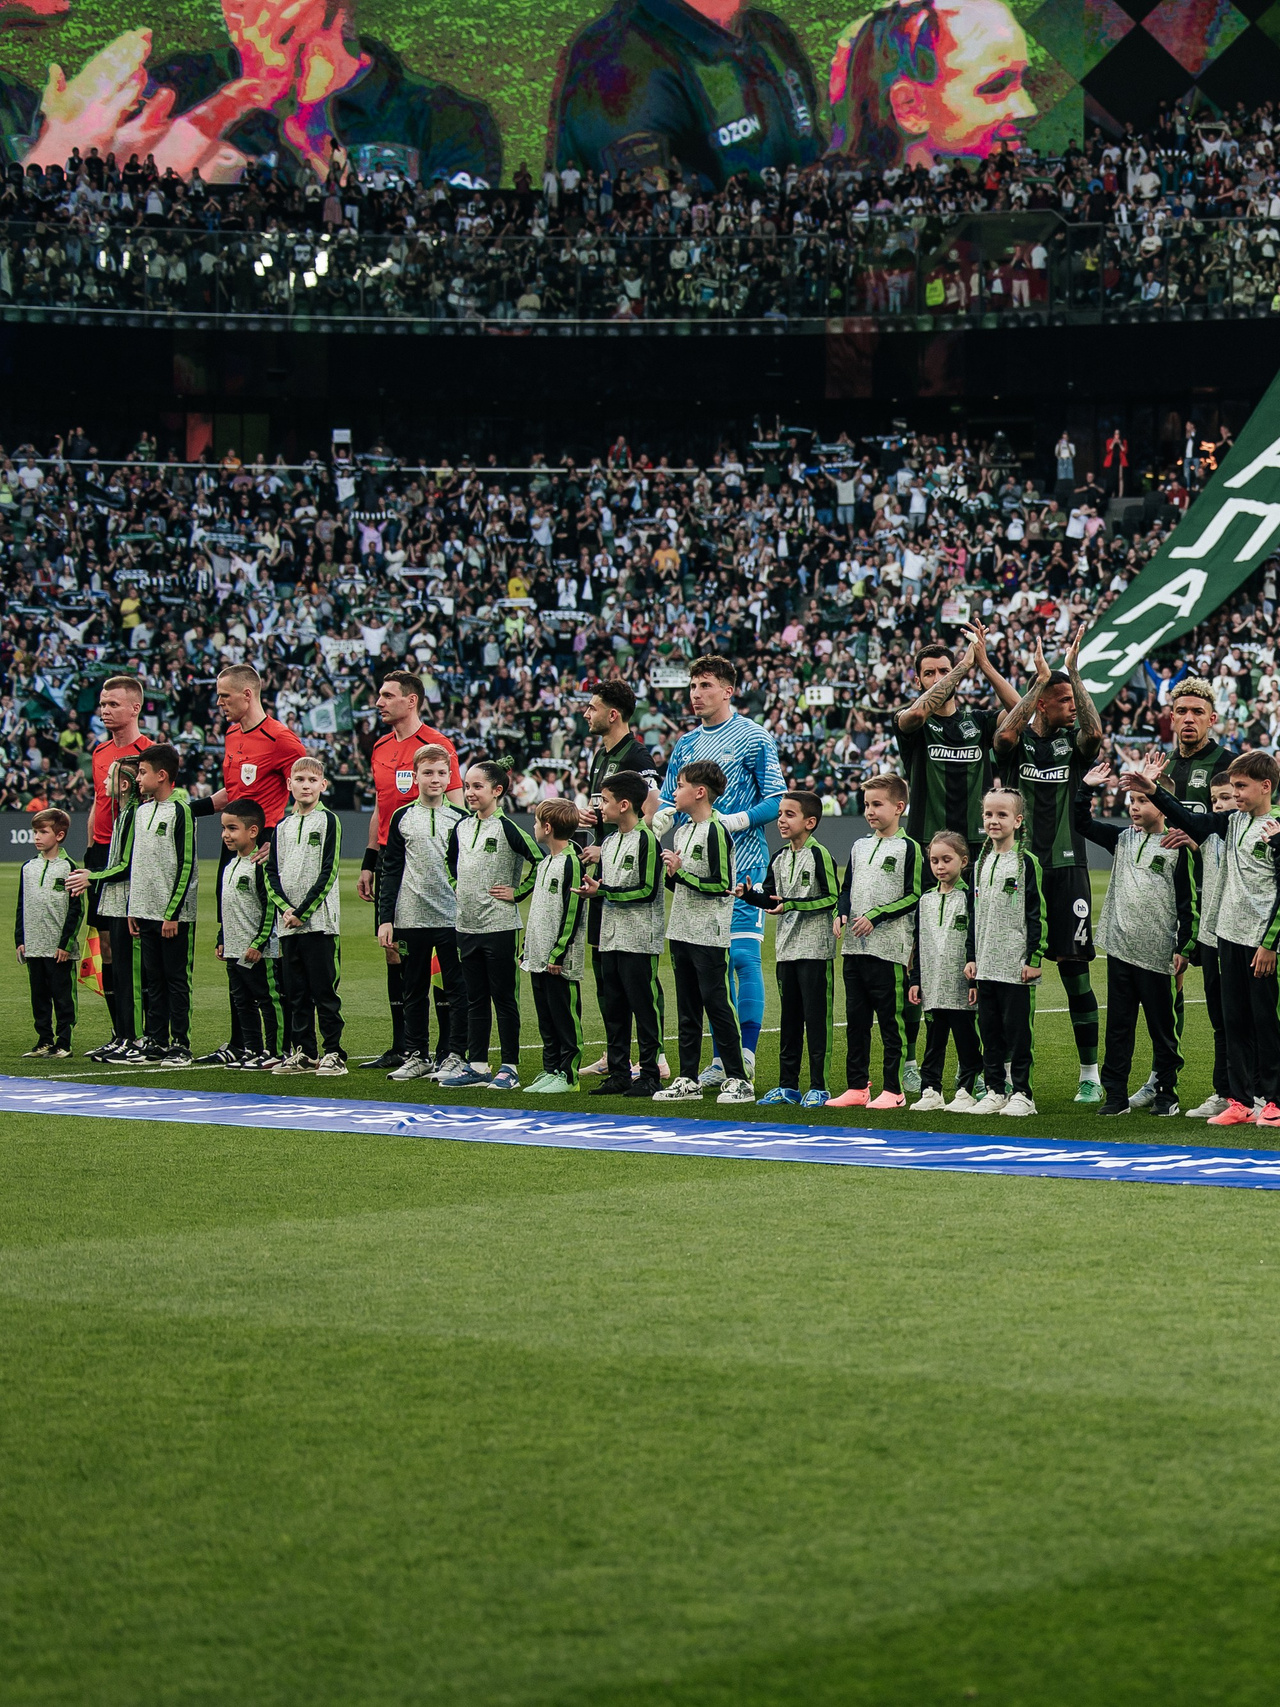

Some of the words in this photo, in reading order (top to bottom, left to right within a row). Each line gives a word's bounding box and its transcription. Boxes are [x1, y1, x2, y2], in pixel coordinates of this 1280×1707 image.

[930, 747, 975, 759] WINLINE
[1022, 766, 1064, 780] WINLINE
[1077, 904, 1086, 912] hh
[1074, 919, 1088, 946] 4
